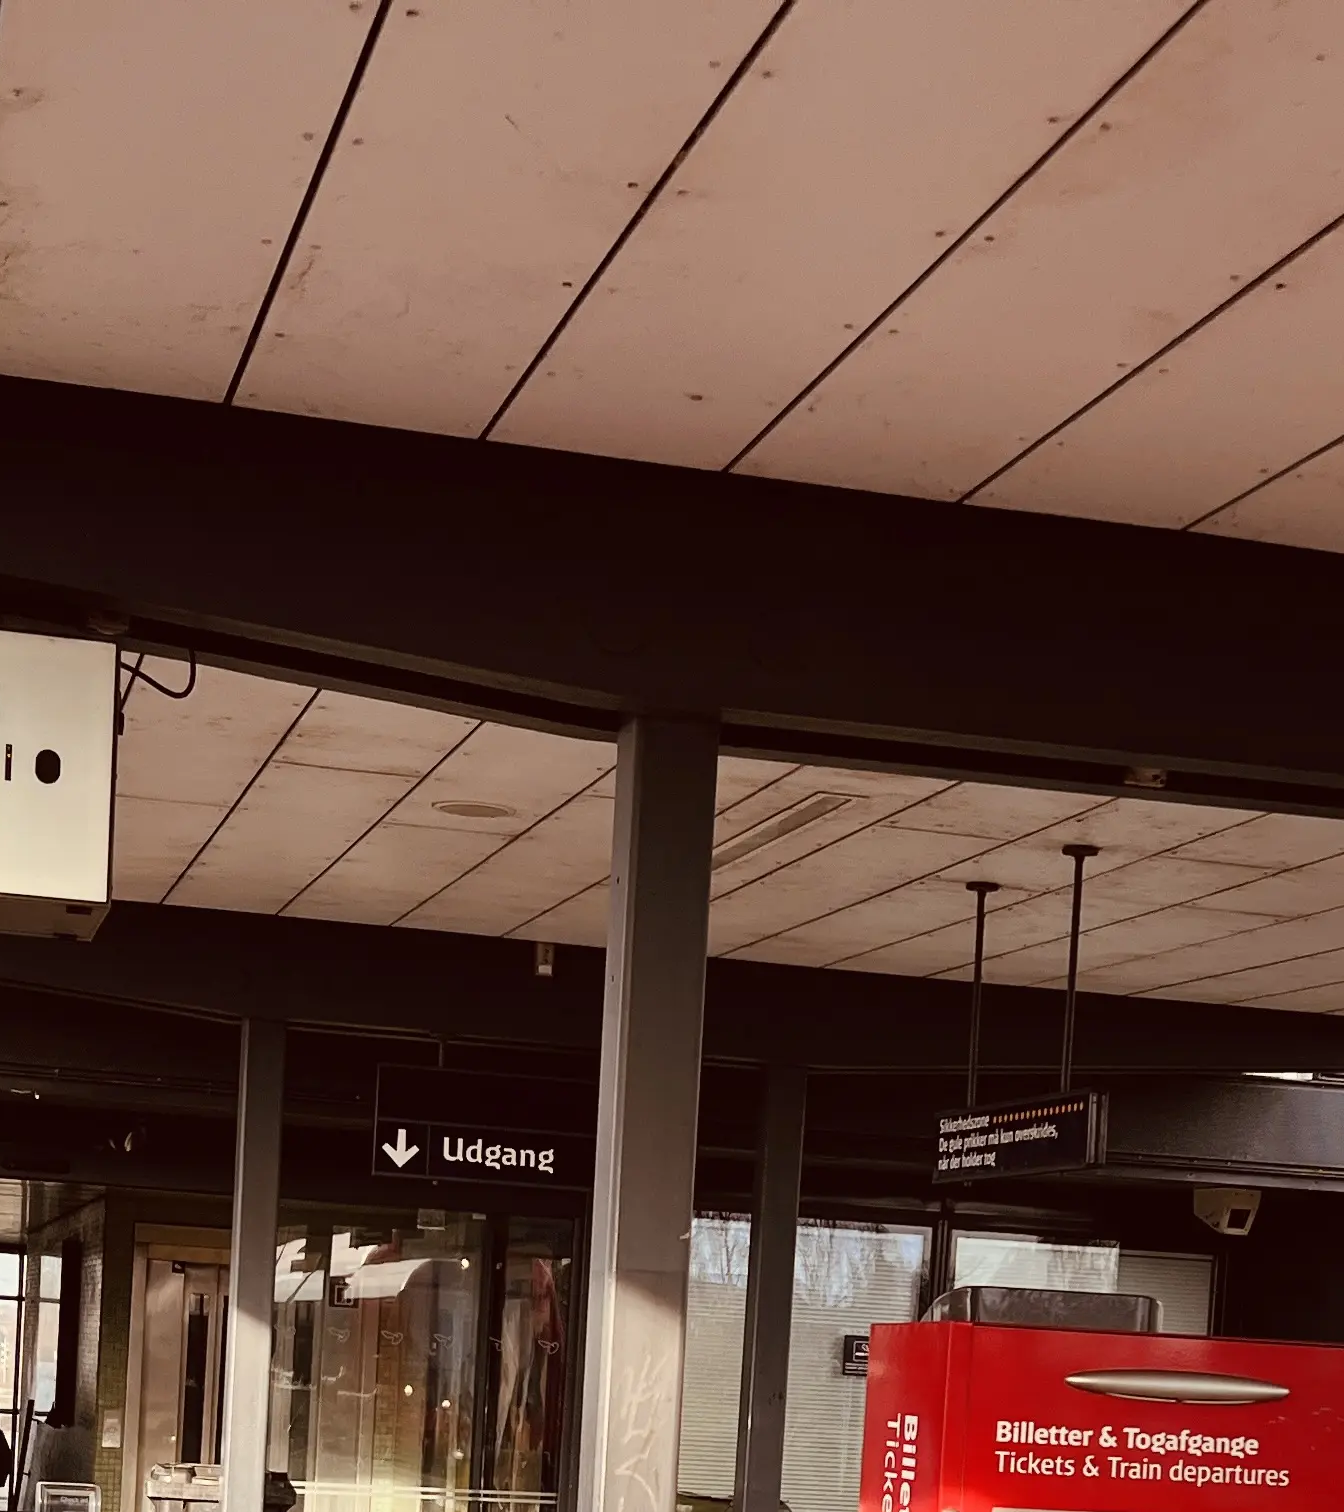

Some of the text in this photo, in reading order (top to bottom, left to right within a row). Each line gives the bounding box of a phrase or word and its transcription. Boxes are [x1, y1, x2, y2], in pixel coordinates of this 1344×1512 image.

[442, 1136, 555, 1174] Udgang
[995, 1420, 1260, 1459] Billetter & Togafgange
[994, 1450, 1291, 1487] Tickets & Train departures
